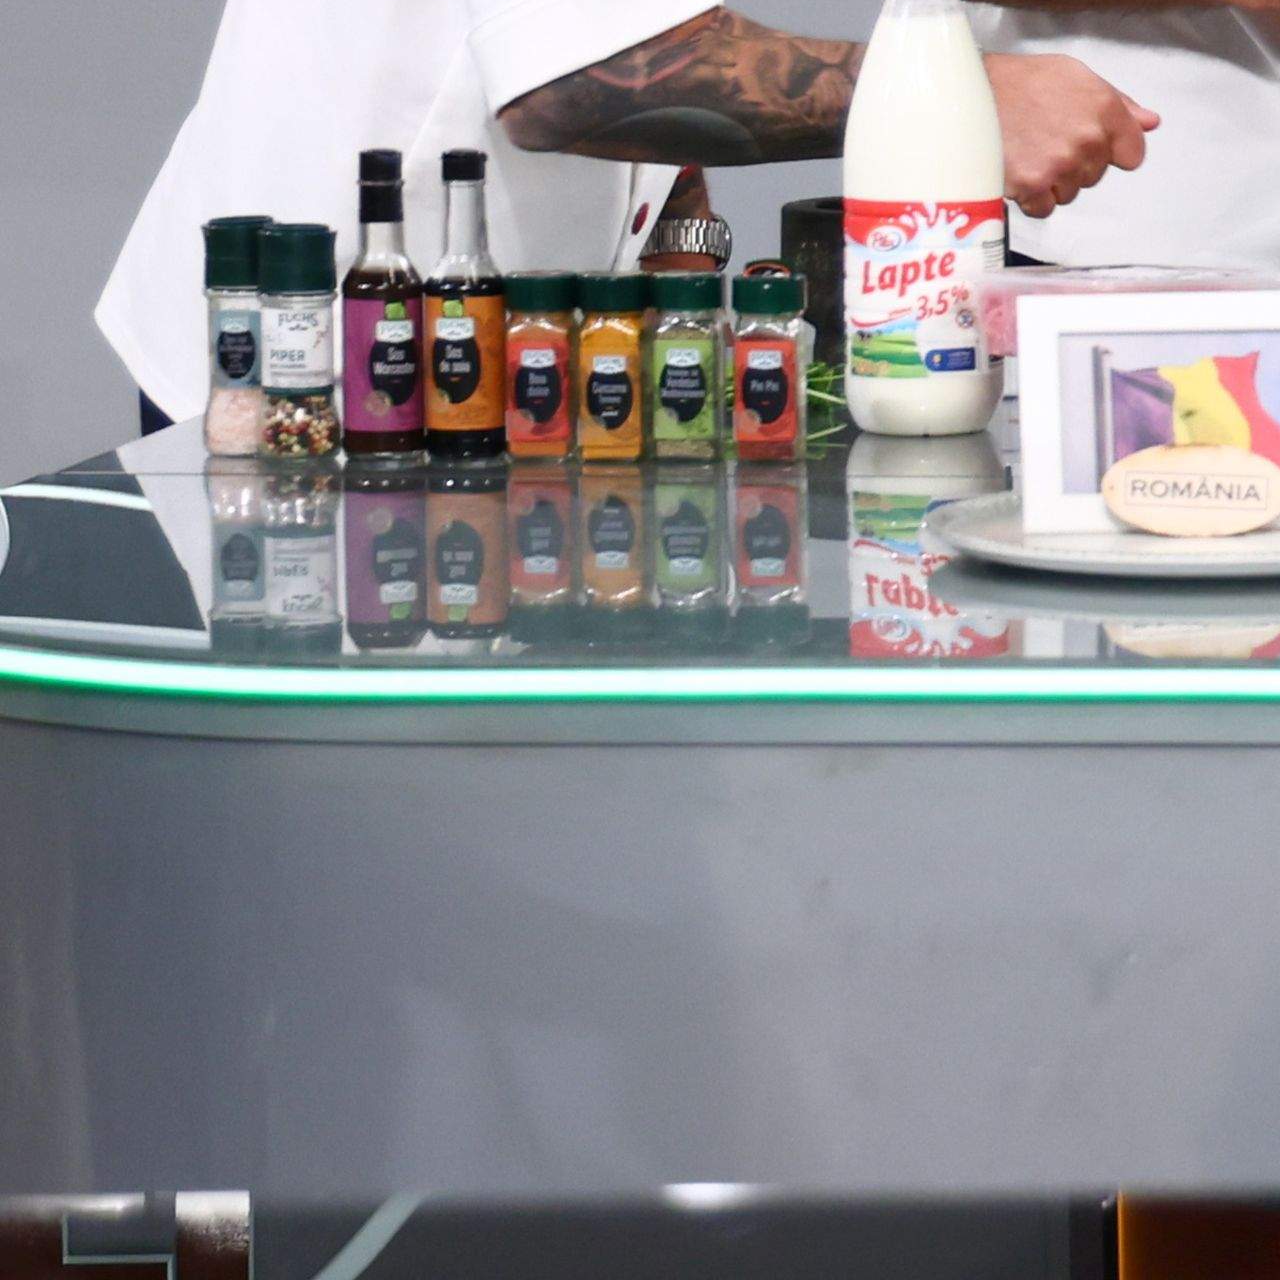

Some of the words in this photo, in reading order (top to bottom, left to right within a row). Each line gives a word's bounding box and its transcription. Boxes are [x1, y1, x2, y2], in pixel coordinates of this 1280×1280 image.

[861, 251, 956, 297] Lapte
[916, 284, 970, 321] 3,5%
[270, 349, 305, 361] PIPER
[1130, 477, 1262, 502] ROMÂNIA
